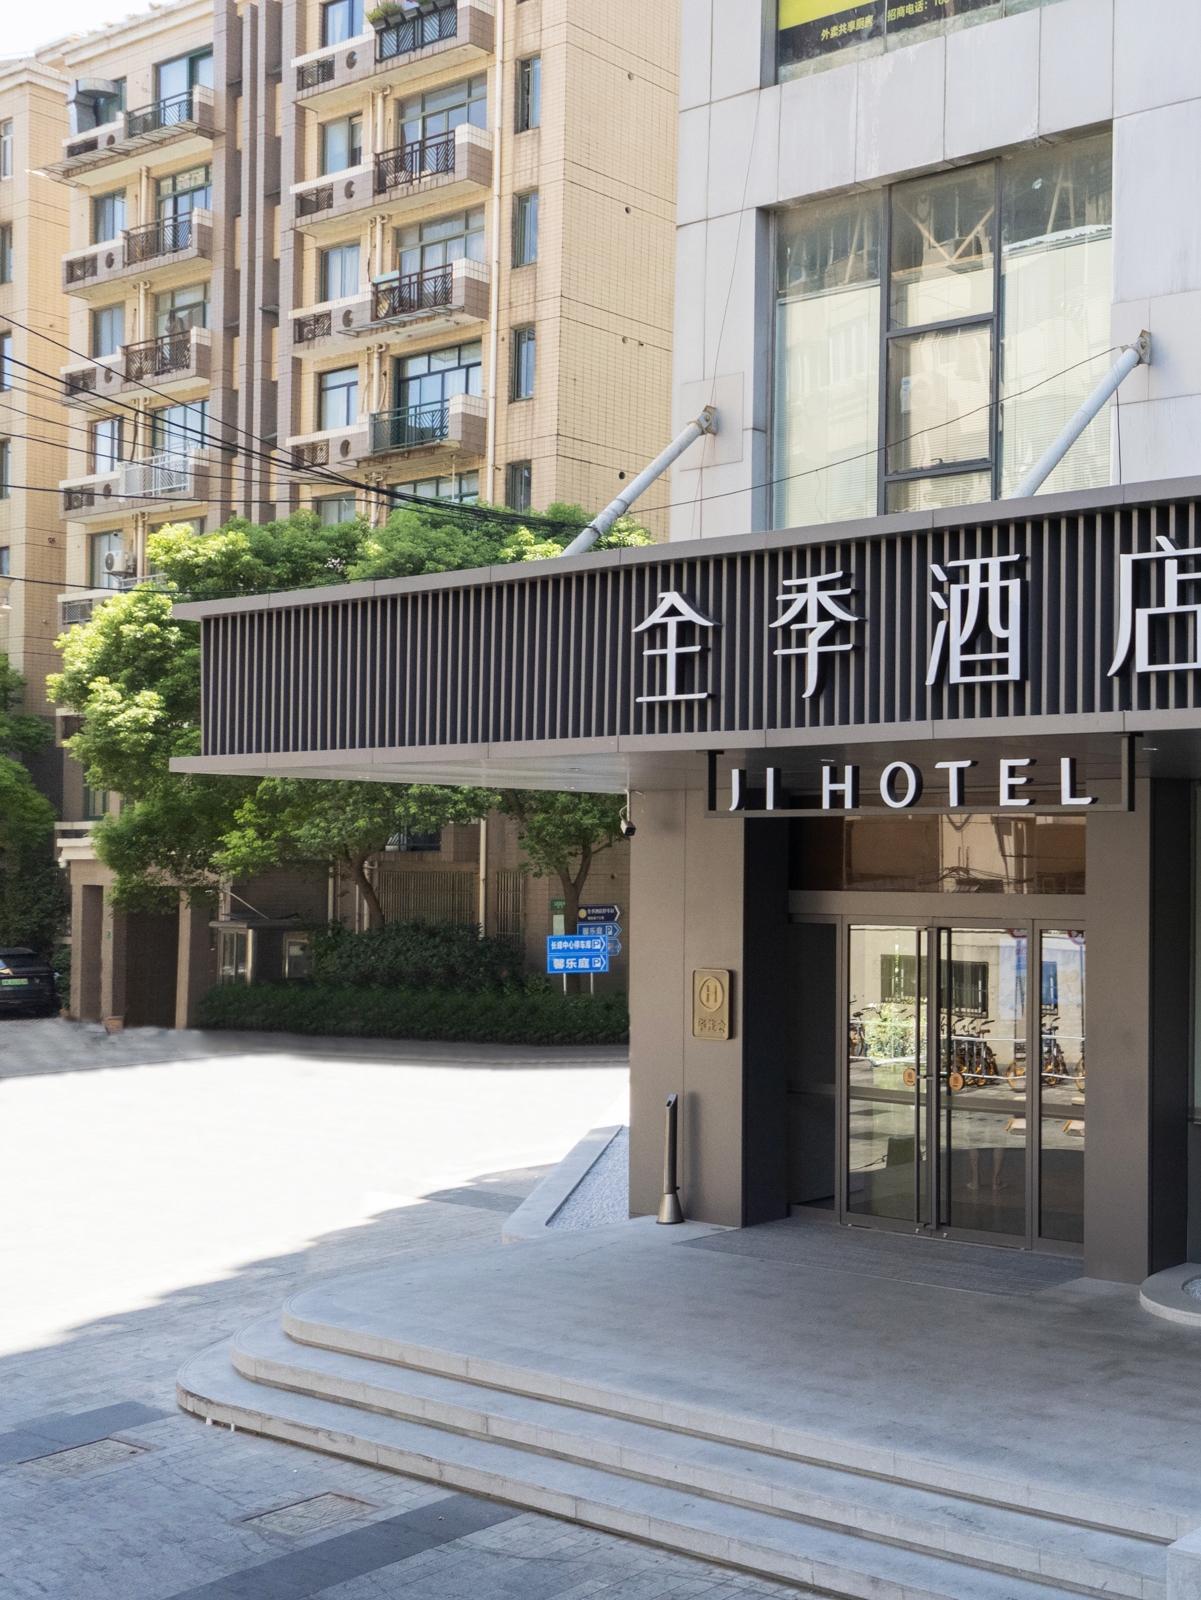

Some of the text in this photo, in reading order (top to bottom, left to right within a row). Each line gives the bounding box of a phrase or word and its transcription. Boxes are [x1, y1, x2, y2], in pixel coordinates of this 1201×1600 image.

[820, 14, 874, 41] 外卖共享厨房
[729, 756, 1094, 811] JI HOTEL
[553, 958, 590, 969] 馨乐庭
